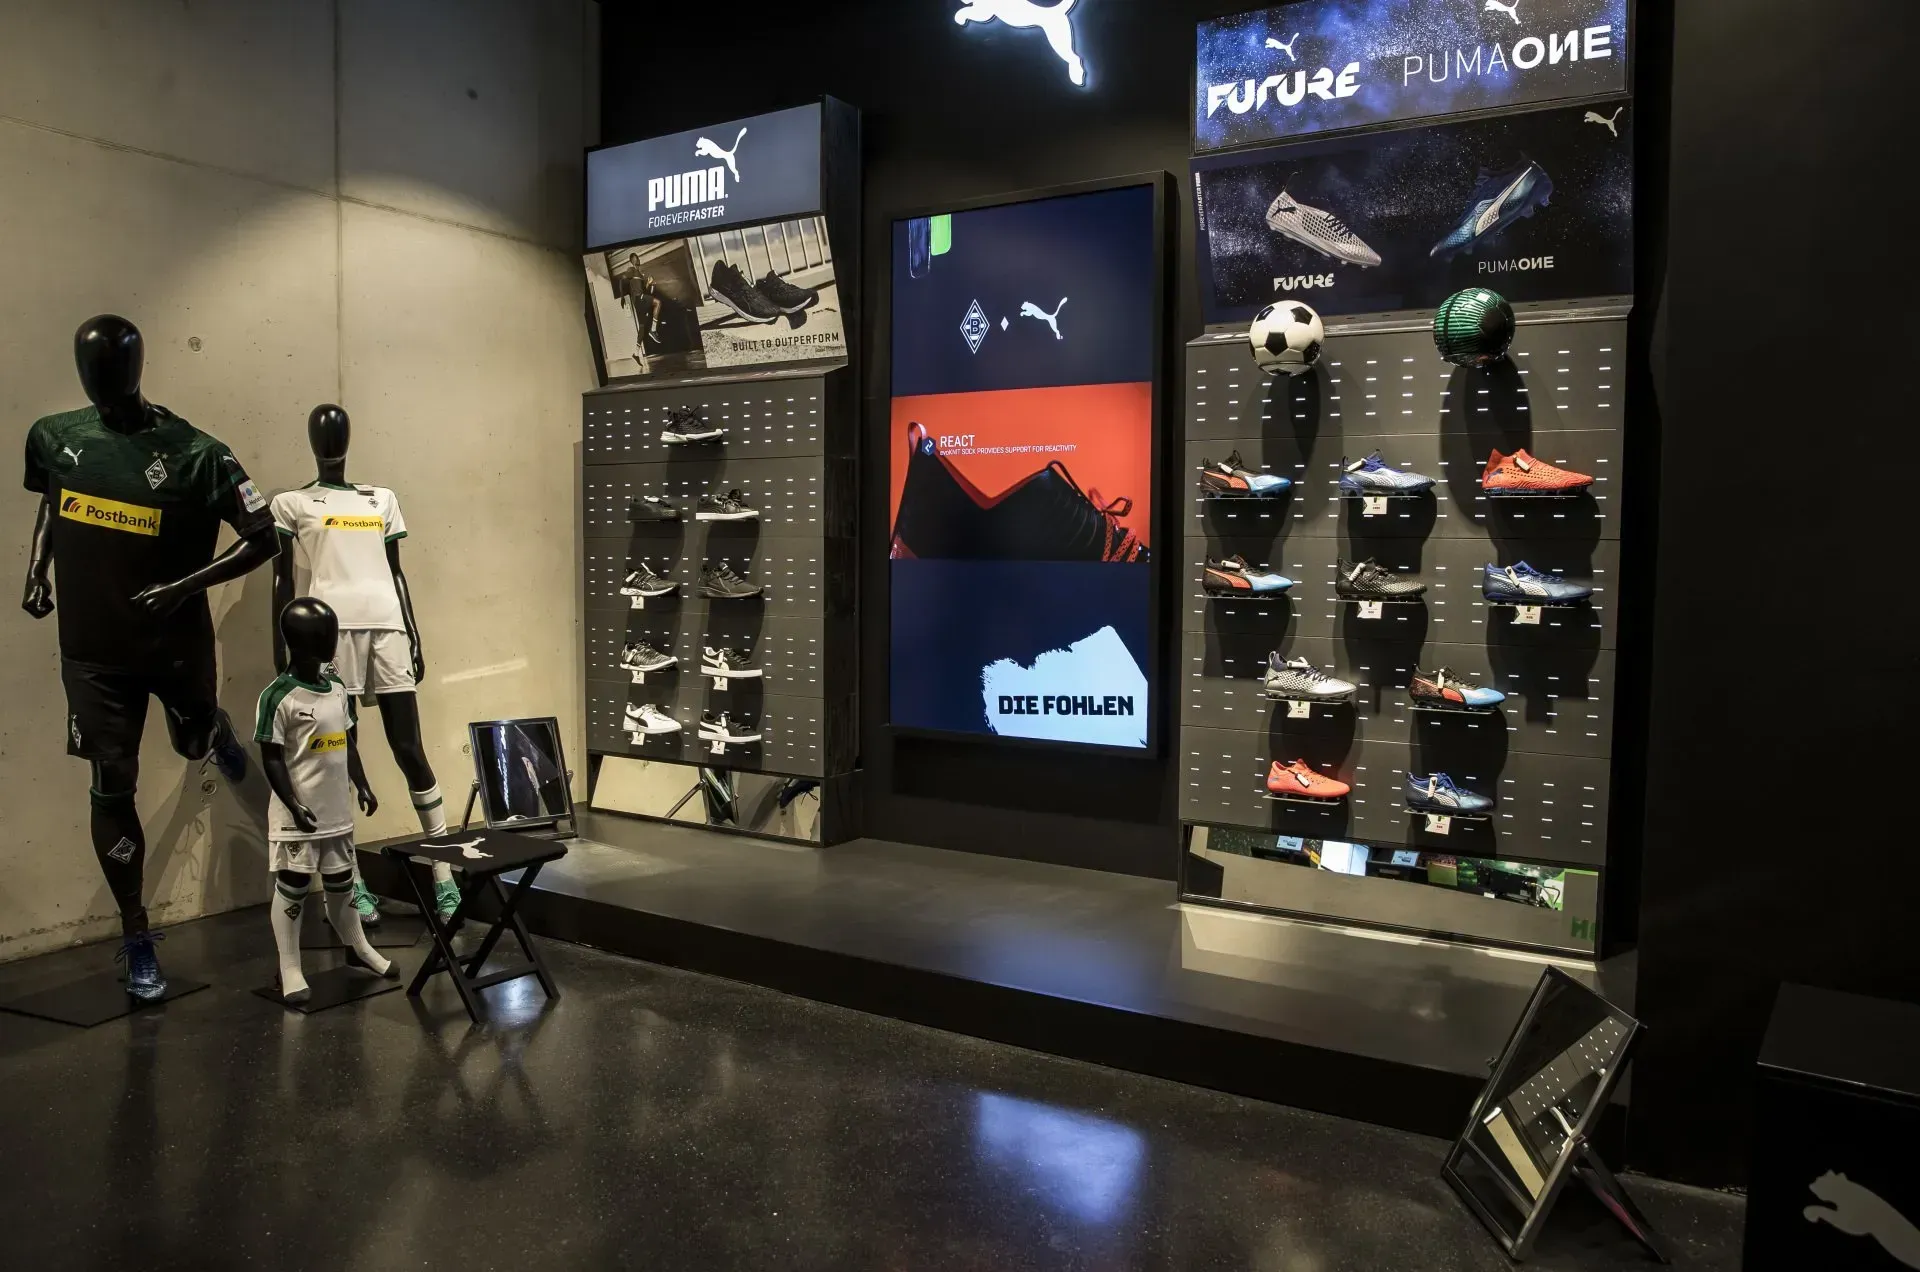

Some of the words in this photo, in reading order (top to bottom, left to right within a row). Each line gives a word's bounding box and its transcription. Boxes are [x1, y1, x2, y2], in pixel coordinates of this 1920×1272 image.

[1403, 25, 1612, 87] PUMAONE
[1207, 62, 1361, 119] FUTURE
[648, 165, 725, 212] PUMA
[1478, 255, 1555, 274] PUMAONE
[1273, 273, 1335, 292] FUTURE
[732, 341, 757, 351] BUILT
[761, 339, 772, 349] TO
[775, 332, 839, 348] OUTPERFORM
[940, 434, 975, 448] REACT
[961, 447, 976, 455] SOCK
[977, 446, 1005, 454] PROVIDES
[1005, 445, 1031, 454] SUPPORT
[1032, 445, 1044, 453] FOR
[1044, 444, 1077, 452] REACTIVITY
[85, 504, 157, 530] Postbank
[998, 696, 1038, 715] DIE
[1043, 695, 1134, 716] FOHLEN
